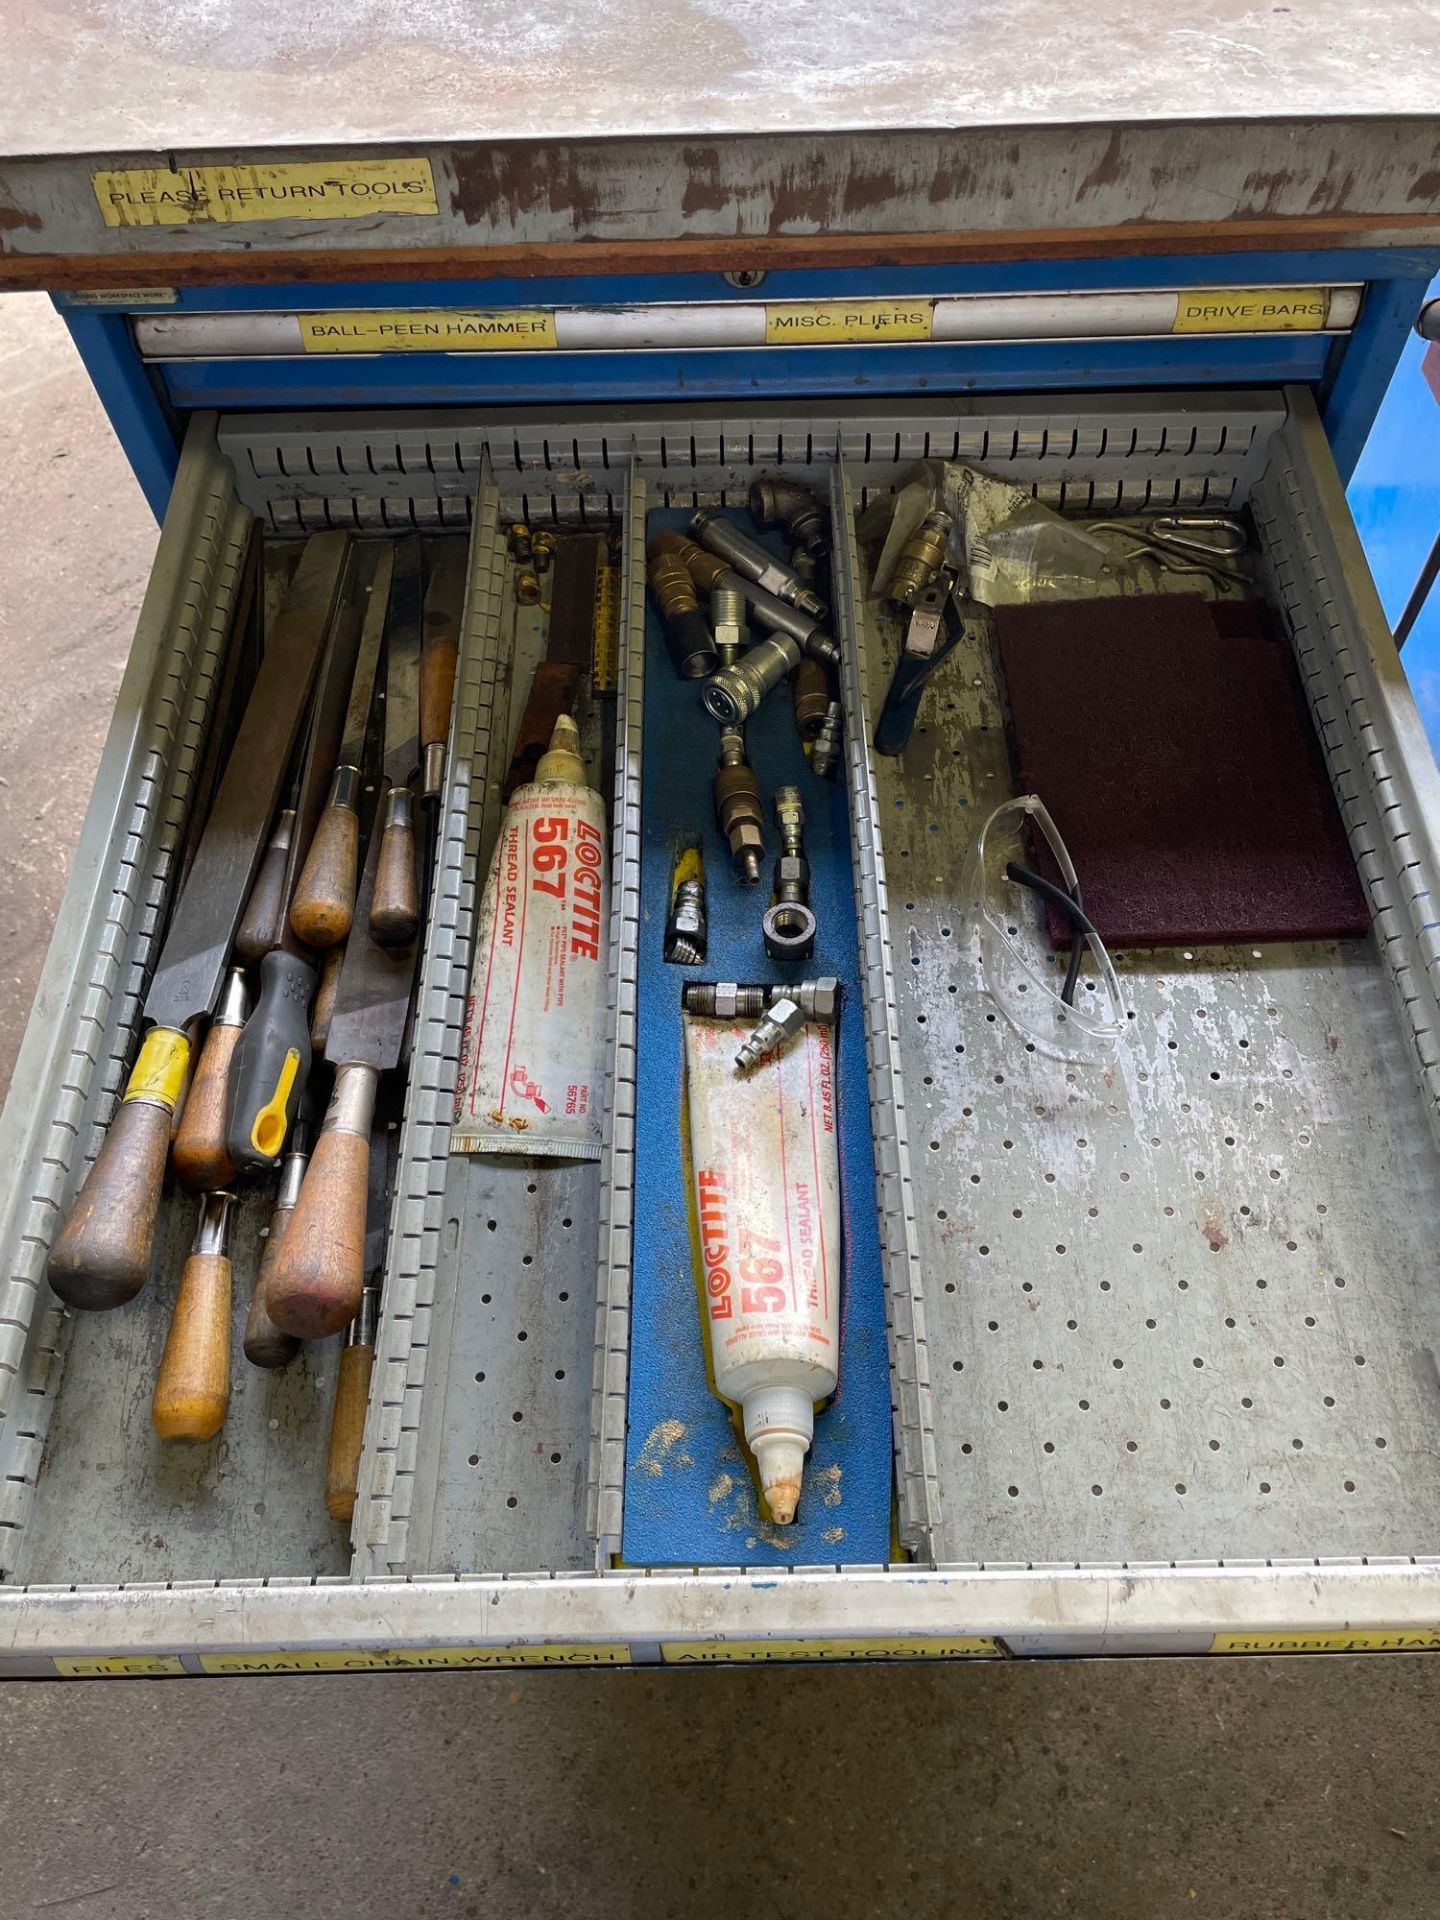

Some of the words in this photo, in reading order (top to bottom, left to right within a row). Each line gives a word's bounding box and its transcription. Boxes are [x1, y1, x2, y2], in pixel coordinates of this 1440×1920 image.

[109, 190, 208, 205] PLEASE
[218, 185, 326, 200] RETURN
[335, 181, 424, 196] TOOLS
[776, 315, 836, 328] MISC.
[845, 313, 924, 326] PLIERS
[1186, 305, 1255, 318] DRIVE
[1262, 304, 1323, 316] BARS
[311, 323, 439, 337] BALL-PEEN
[447, 321, 546, 334] HAMMER
[507, 824, 519, 881] THREAD
[501, 886, 517, 947] SEALANT
[819, 1039, 832, 1060] (250
[566, 1084, 577, 1114] 56765
[580, 1085, 588, 1101] PART
[822, 1091, 832, 1112] 8.45
[823, 1113, 833, 1133] NET
[796, 1182, 813, 1245] SEALANT
[678, 1651, 731, 1660] AIR
[743, 1650, 833, 1659] TEST
[844, 1648, 998, 1657] TOOLING
[1229, 1639, 1370, 1650] RUBBER
[72, 1664, 168, 1674] FILES
[220, 1661, 322, 1671] SMALL
[345, 1657, 449, 1667] CHAIN
[462, 1653, 615, 1664] WRENCH
